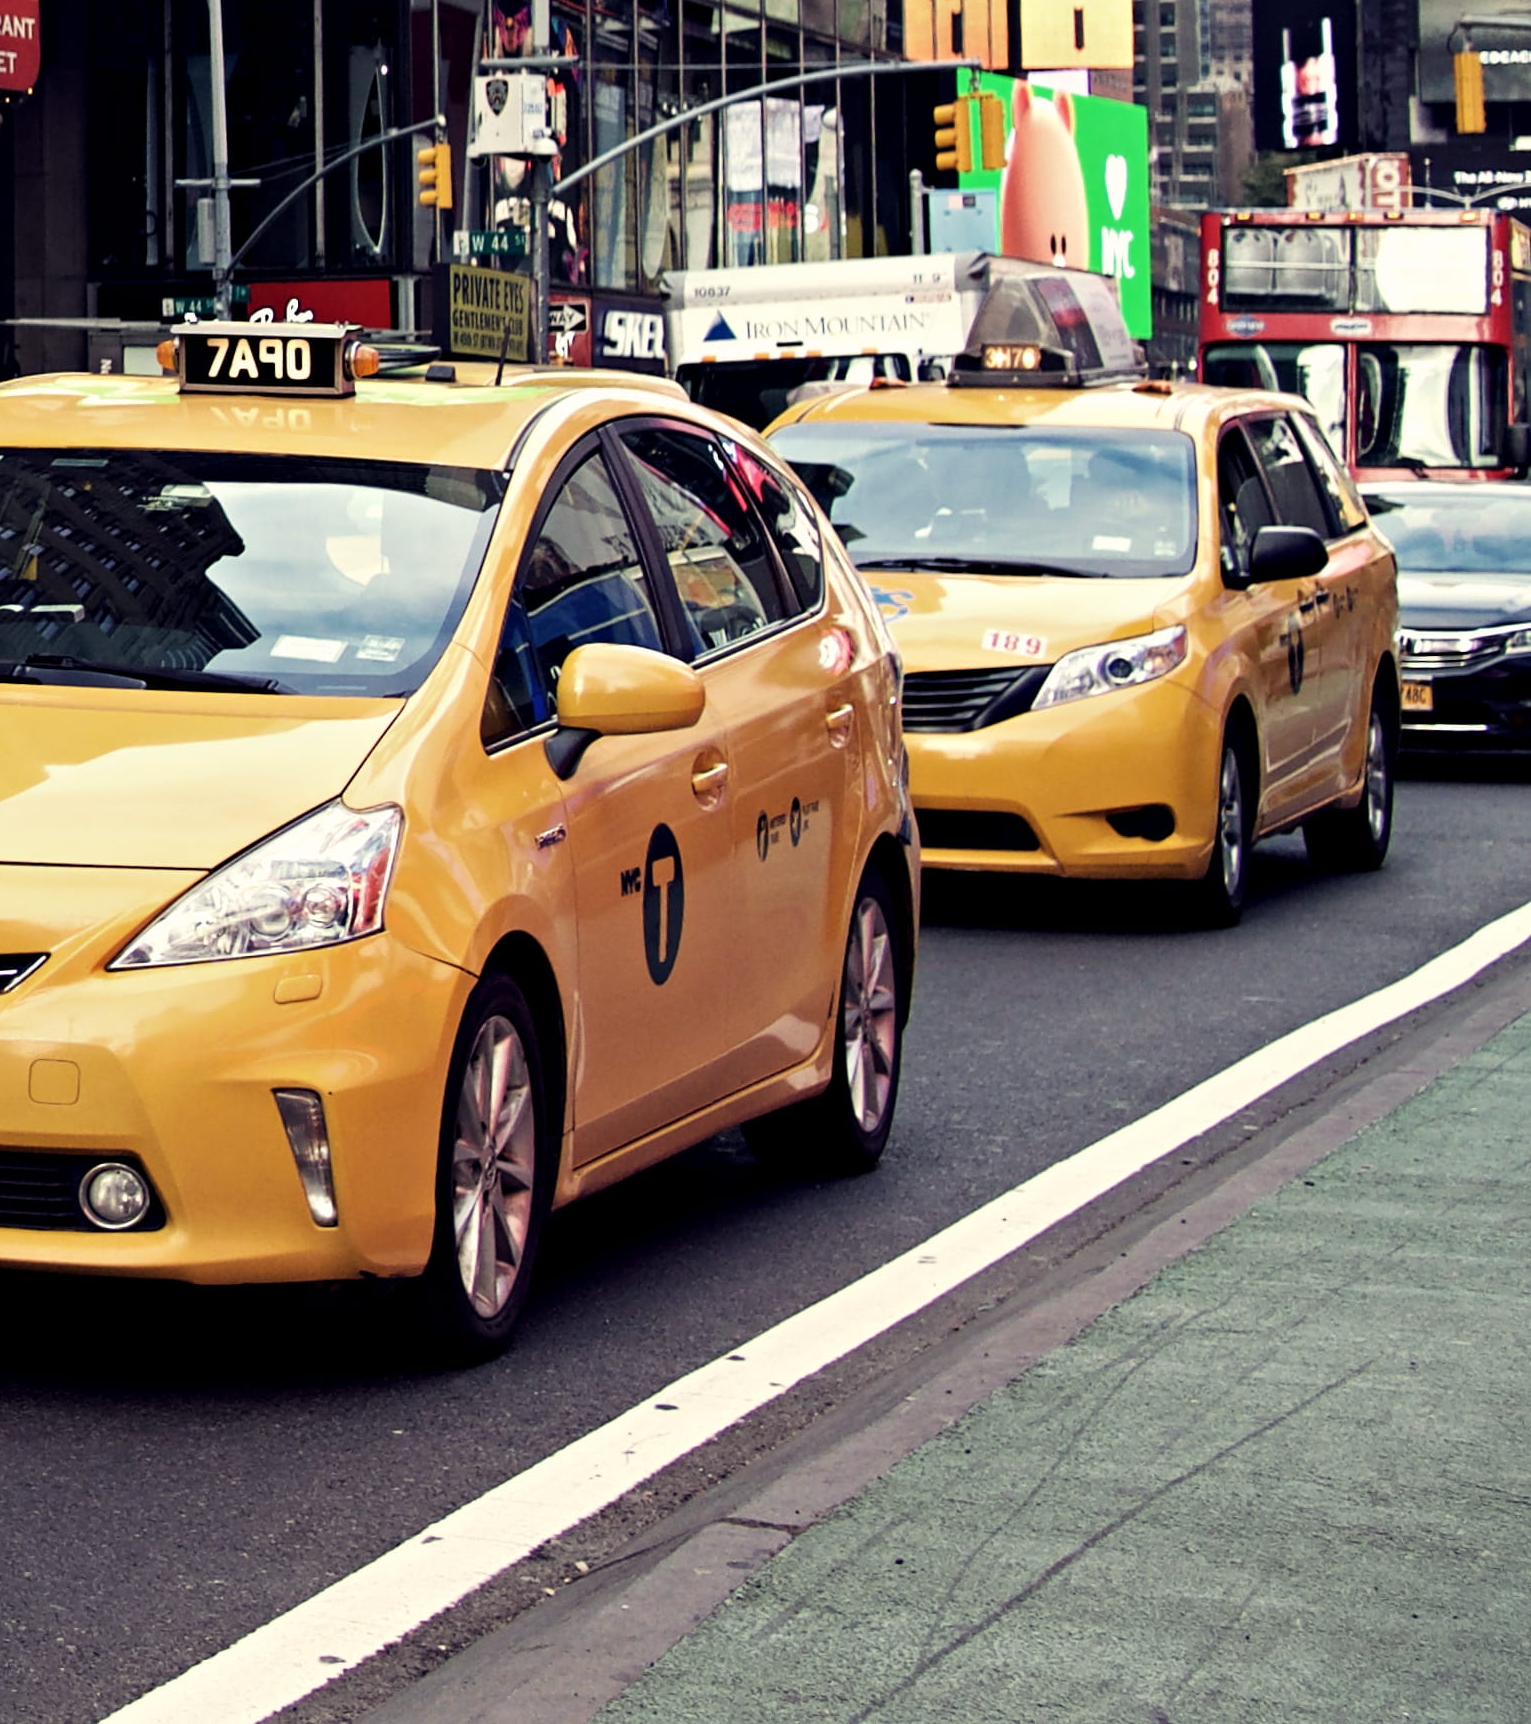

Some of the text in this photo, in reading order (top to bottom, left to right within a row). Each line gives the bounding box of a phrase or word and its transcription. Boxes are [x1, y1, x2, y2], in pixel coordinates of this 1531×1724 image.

[471, 234, 485, 252] W
[491, 234, 509, 252] 44
[175, 299, 186, 314] W
[189, 299, 203, 314] 44
[453, 272, 524, 315] PRIVATE EYES
[747, 310, 928, 340] IRON MOUNTAIN
[206, 337, 313, 380] 7A90
[620, 866, 642, 898] NYC
